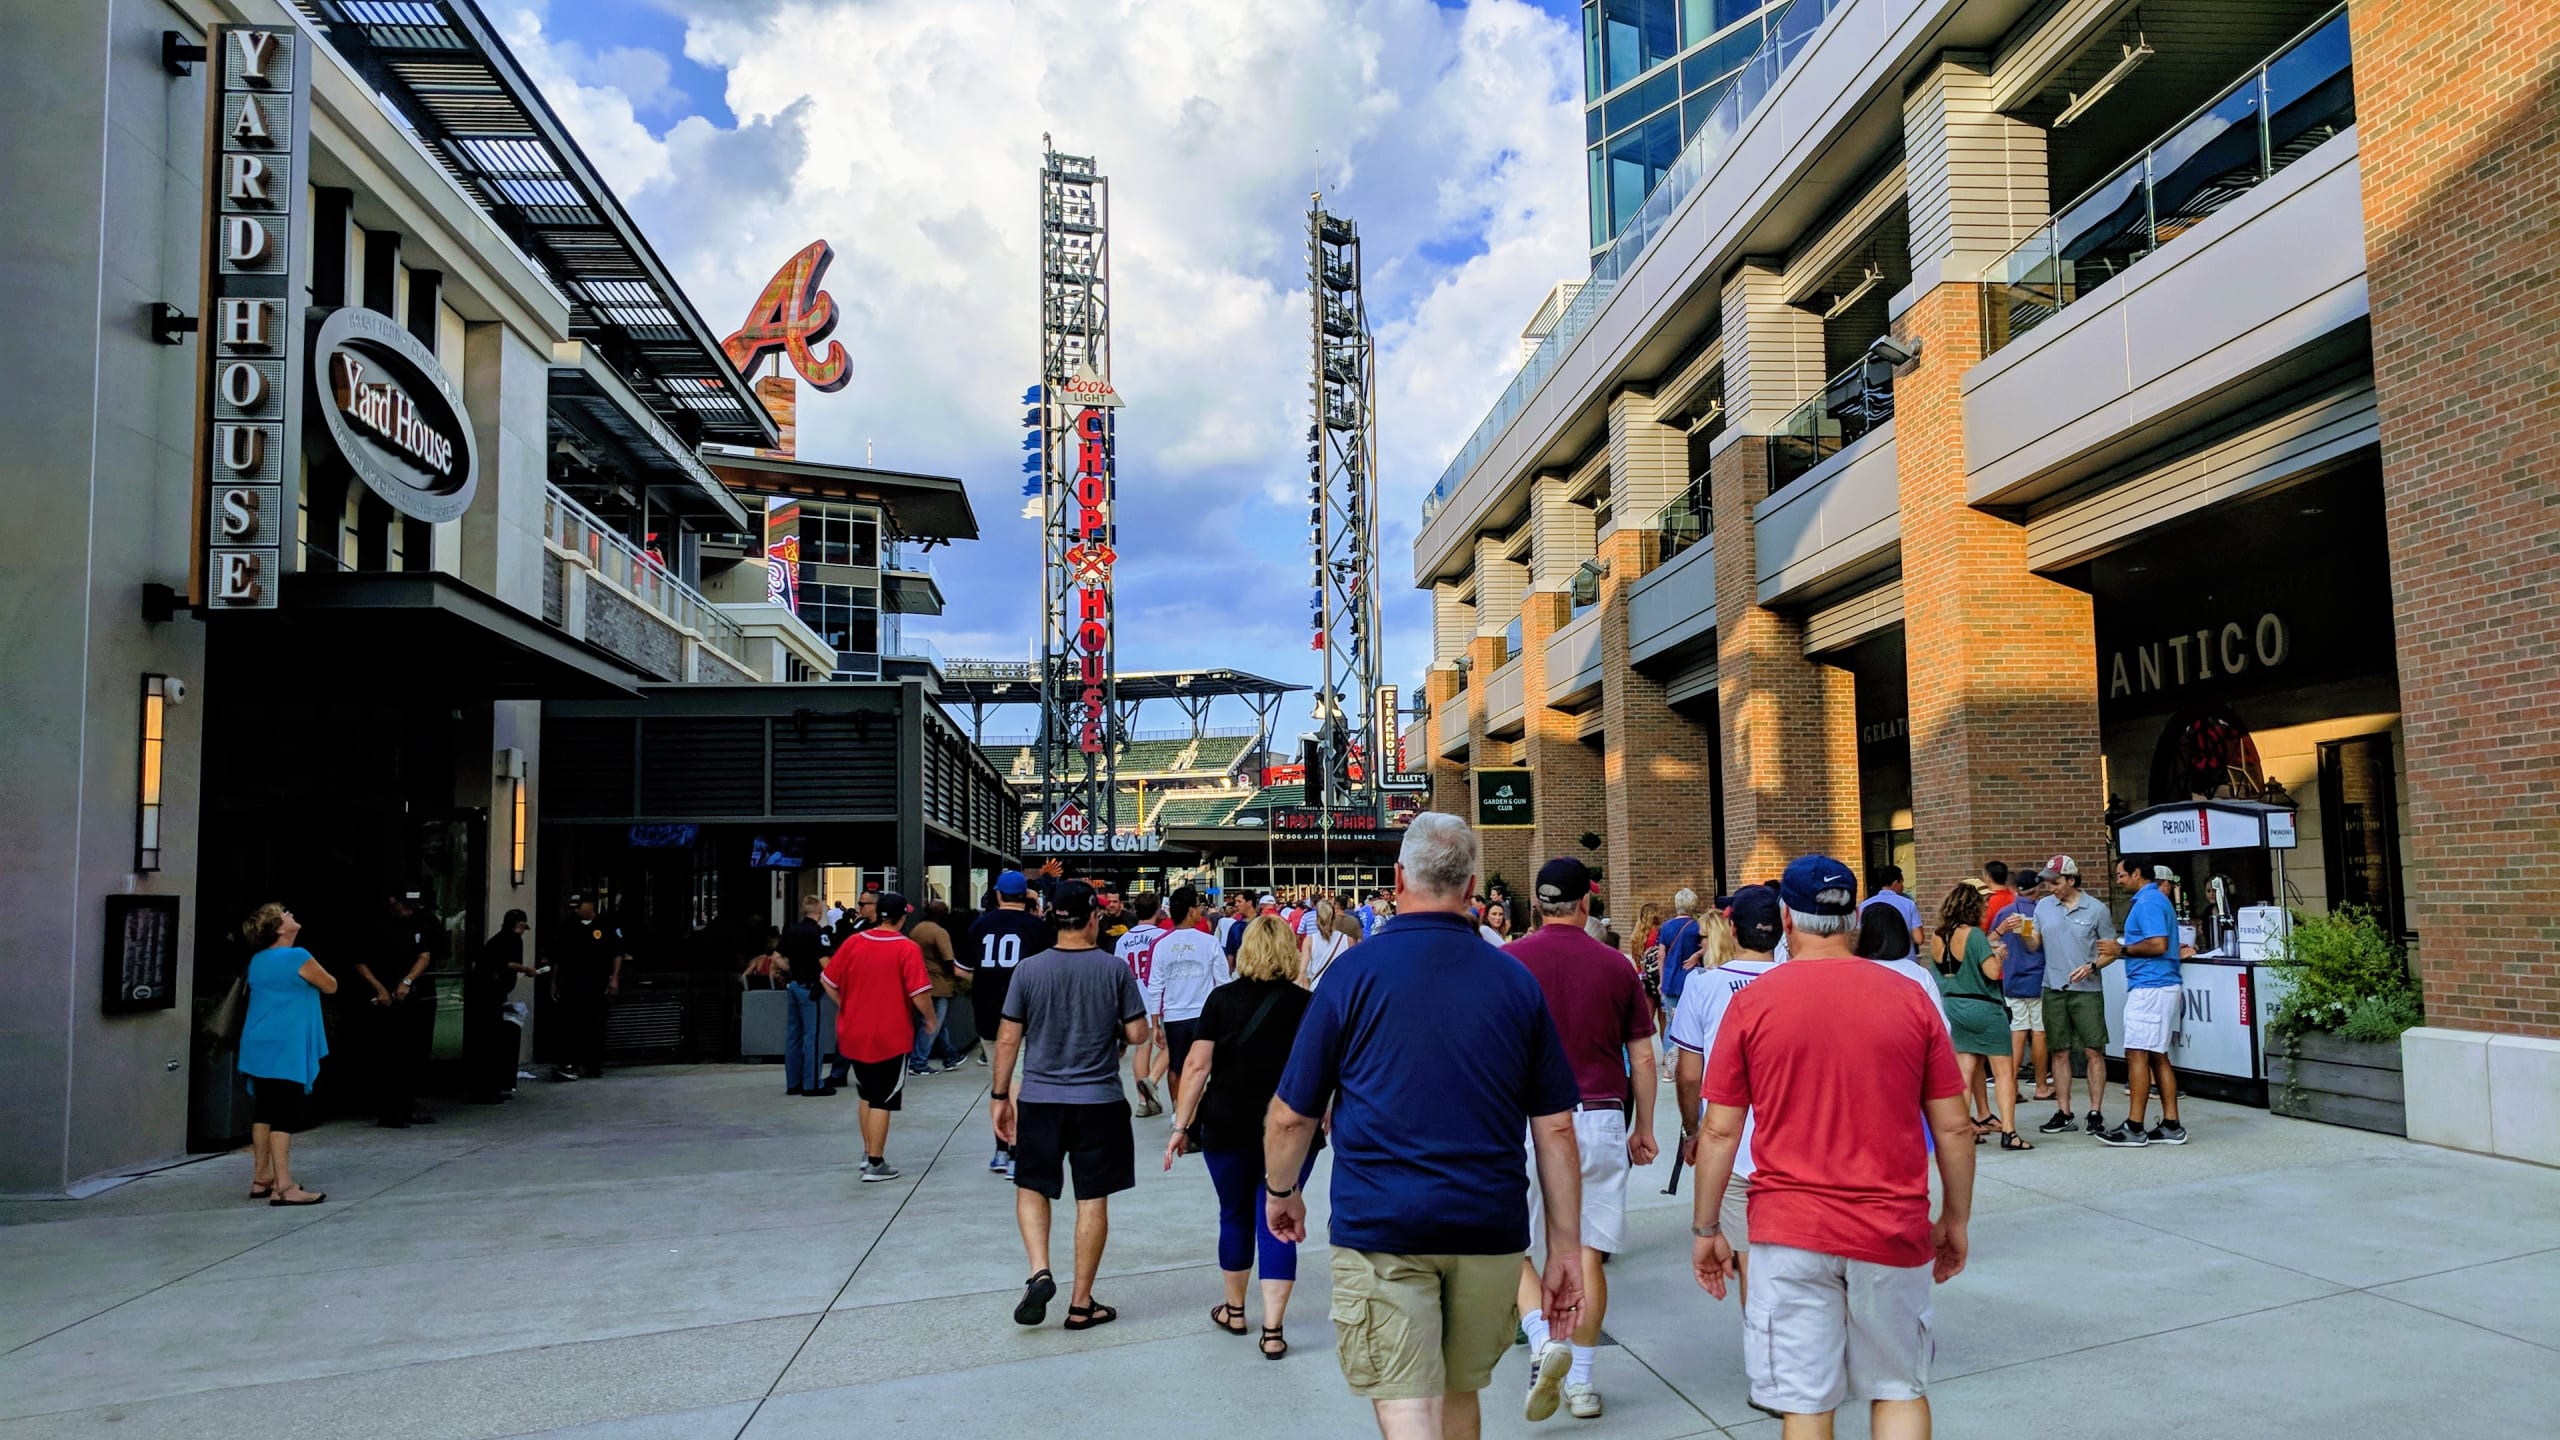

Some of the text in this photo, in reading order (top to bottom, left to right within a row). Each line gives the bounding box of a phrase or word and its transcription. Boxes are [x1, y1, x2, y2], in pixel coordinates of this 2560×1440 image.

[217, 29, 277, 600] YARD HOUSE
[1065, 374, 1116, 394] Coors
[1074, 392, 1107, 403] LIGHT
[342, 352, 453, 475] Yard House
[1078, 408, 1105, 753] CHOP HOUSE
[2111, 612, 2285, 699] ANTICO
[1384, 691, 1397, 774] STEAKHOUSE
[1059, 814, 1082, 831] CH
[1333, 812, 1377, 829] THIRD
[2162, 819, 2196, 835] PERONI
[1036, 834, 1106, 851] HOUSE
[1111, 833, 1161, 852] GATE
[981, 933, 1021, 968] 10
